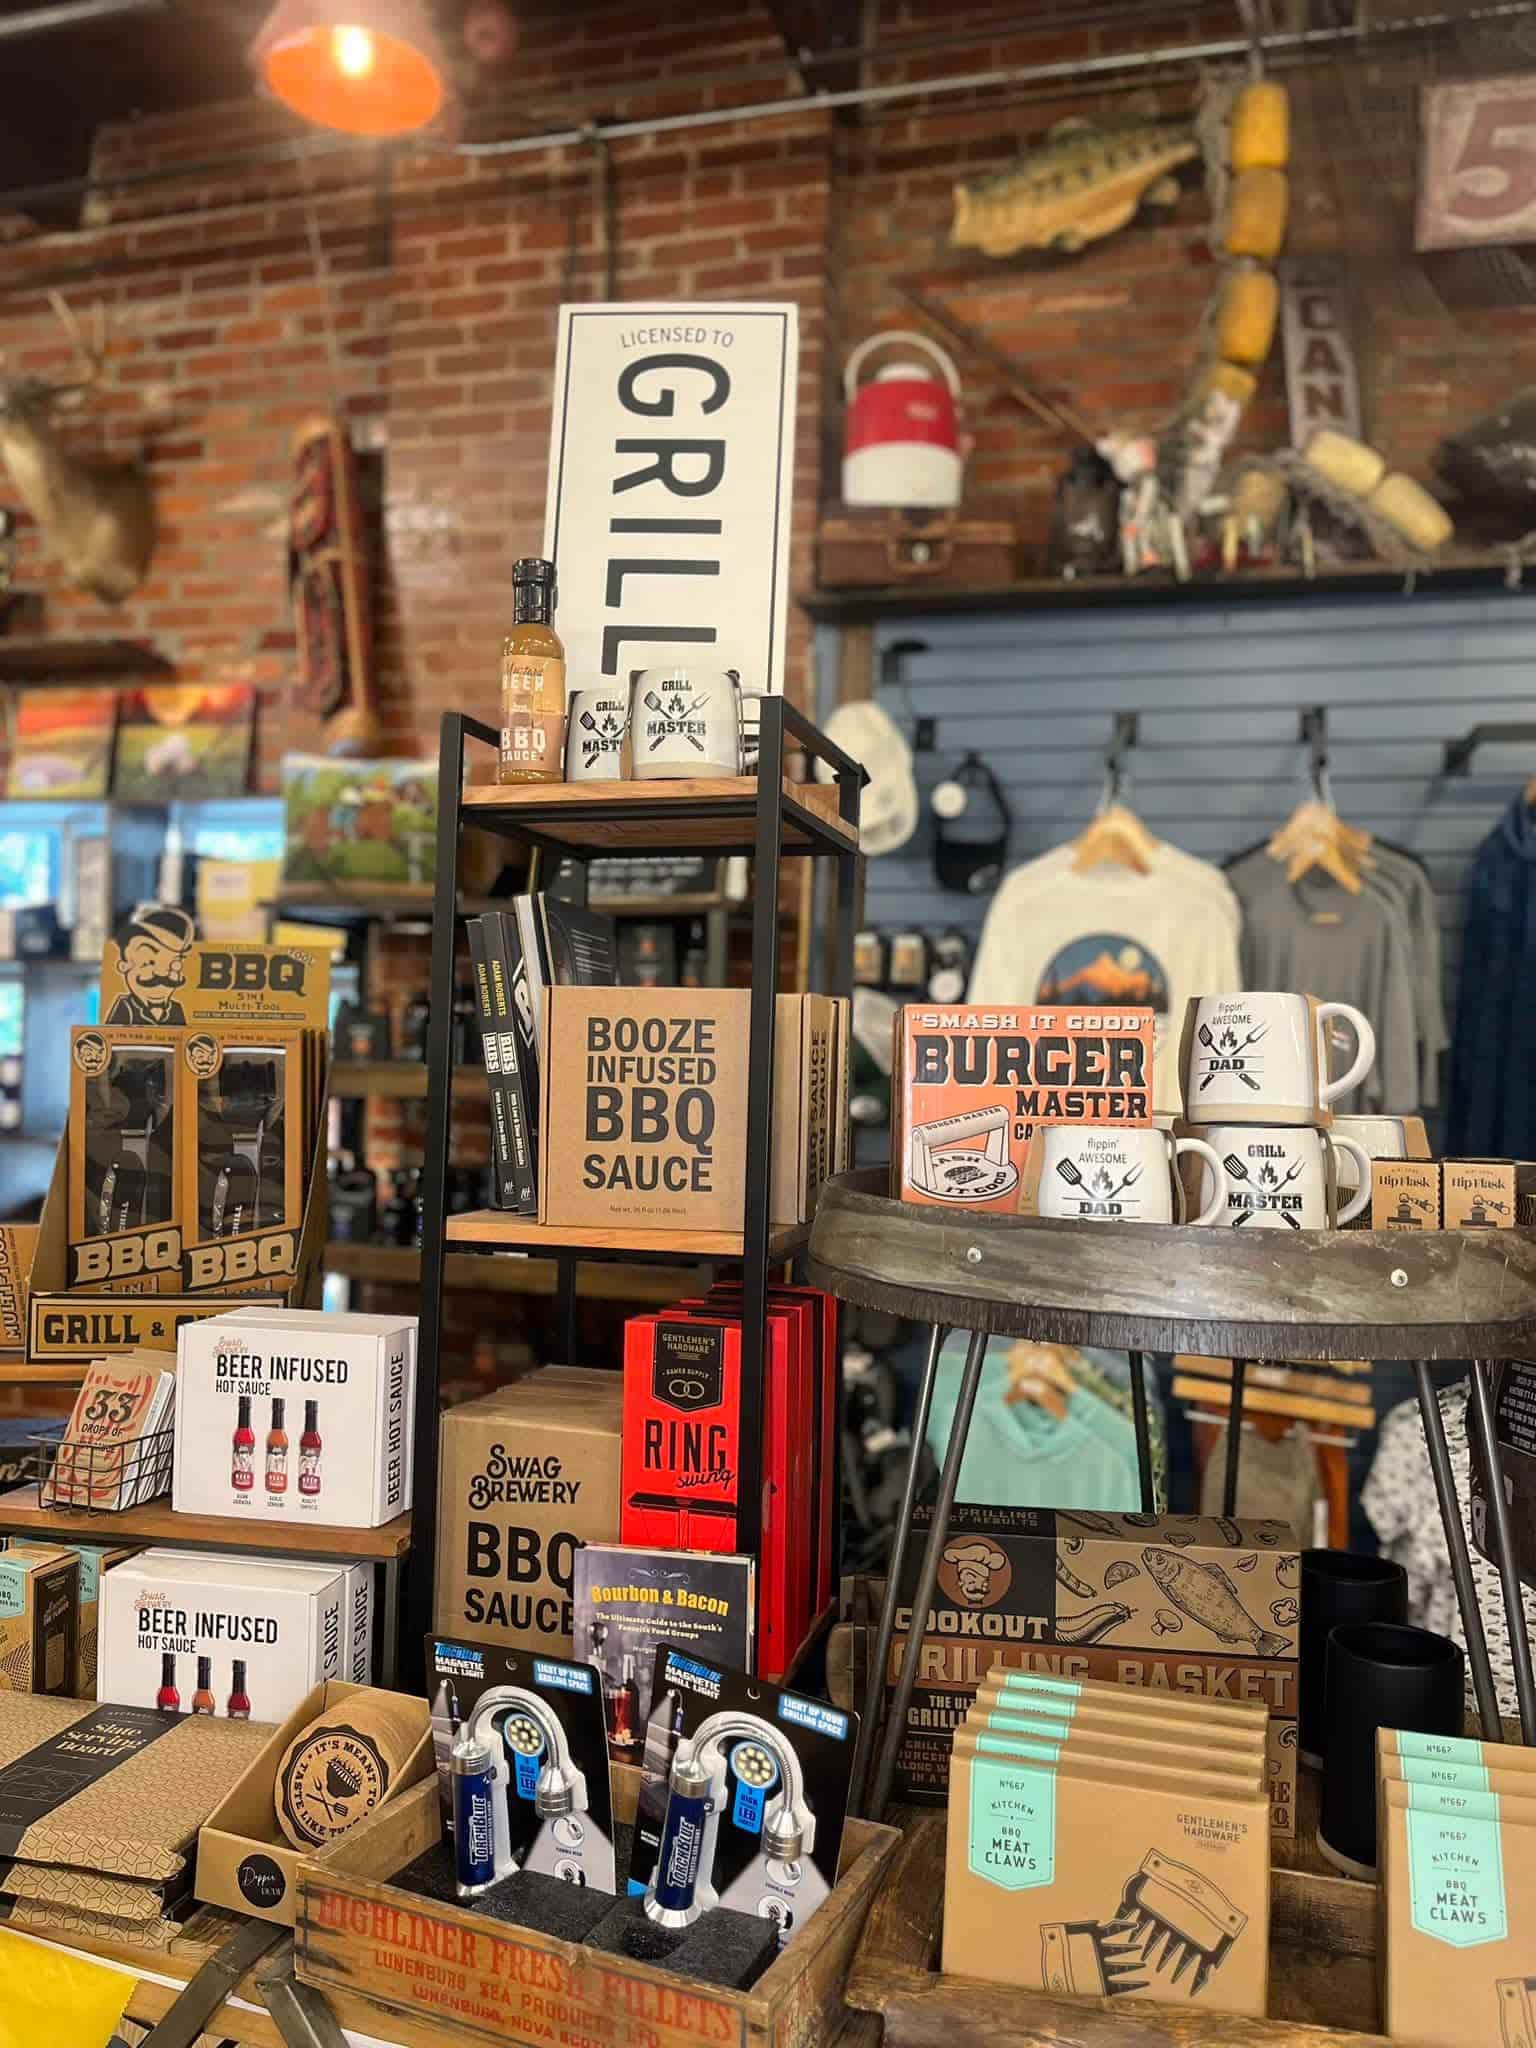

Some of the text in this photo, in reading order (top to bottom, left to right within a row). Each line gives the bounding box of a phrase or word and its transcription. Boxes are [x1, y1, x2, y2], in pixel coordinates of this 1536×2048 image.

[620, 327, 735, 349] LICENSED TO
[601, 353, 731, 676] GRILL
[662, 680, 693, 691] GRILL
[596, 701, 625, 712] GRILL
[647, 720, 706, 736] MASTER
[197, 952, 306, 997] BBQ
[1030, 1014, 1056, 1030] IT
[1212, 1014, 1253, 1026] AWESOME
[587, 1017, 716, 1054] BOOZE
[586, 1056, 717, 1085] INFUSED
[912, 1035, 1147, 1088] BURGER
[1209, 1059, 1245, 1071] DAD
[1014, 1090, 1148, 1118] MASTER
[585, 1087, 716, 1155] BBQ
[1078, 1153, 1128, 1165] AWESOME
[1247, 1144, 1286, 1158] GRILL
[583, 1154, 713, 1192] SAUCE
[1379, 1175, 1430, 1189] Hip Flask
[1451, 1176, 1506, 1190] Hip Flask
[1079, 1201, 1123, 1216] DAD
[1227, 1194, 1303, 1211] MASTER
[75, 1229, 182, 1284] BBQ
[189, 1232, 297, 1289] BBQ
[44, 1314, 140, 1345] GRILL
[151, 1321, 165, 1337] &
[662, 1333, 716, 1347] GENTLEMEN'S
[667, 1342, 710, 1354] HARDWARE
[216, 1354, 349, 1384] BEER INFUSED
[215, 1380, 272, 1396] HOT SAUCE
[86, 1389, 141, 1423] 33
[387, 1351, 404, 1506] BEER HOT SAUCE
[644, 1419, 727, 1473] RING
[486, 1444, 562, 1480] SWAG
[675, 1467, 735, 1491] swing
[468, 1475, 581, 1510] BREWERY
[467, 1520, 580, 1600] BBQ
[353, 1581, 368, 1641] SAUCE
[591, 1584, 729, 1617] Bourbon & Bacon
[464, 1587, 574, 1636] SAUCE
[139, 1608, 278, 1644] BEER INFUSED
[324, 1600, 339, 1668] SAUCE
[679, 1620, 692, 1630] the
[138, 1634, 197, 1654] HOT SAUCE
[435, 1655, 485, 1672] MAGNETIC
[435, 1664, 485, 1680] GRILL LIGHT
[537, 1662, 556, 1675] LIGHT
[664, 1673, 721, 1700] GRILL LIGHT
[665, 1664, 721, 1692] MAGNETIC
[1117, 1659, 1293, 1709] BASKET
[783, 1694, 844, 1726] LIGHT UP YOUR
[928, 1694, 952, 1709] THE
[818, 1717, 842, 1735] SPACE
[315, 1740, 377, 1807] IT'S MEANT TO
[294, 1762, 327, 1836] TASTE LIKE
[991, 1800, 1035, 1816] KITCHEN
[739, 1807, 756, 1822] LED
[1176, 1813, 1248, 1833] GENTLEMEN'S
[1001, 1826, 1021, 1838] BBQ
[1183, 1825, 1241, 1841] HARDWARE
[992, 1837, 1031, 1854] MEAT
[985, 1851, 1037, 1870] CLAWS
[1431, 1851, 1480, 1866] KITCHEN
[1446, 1879, 1467, 1891] BBQ
[1436, 1892, 1479, 1908] MEAT
[1430, 1907, 1487, 1925] CLAWS
[318, 1890, 480, 1969] HIGHLINER
[480, 1982, 511, 2007] SEA
